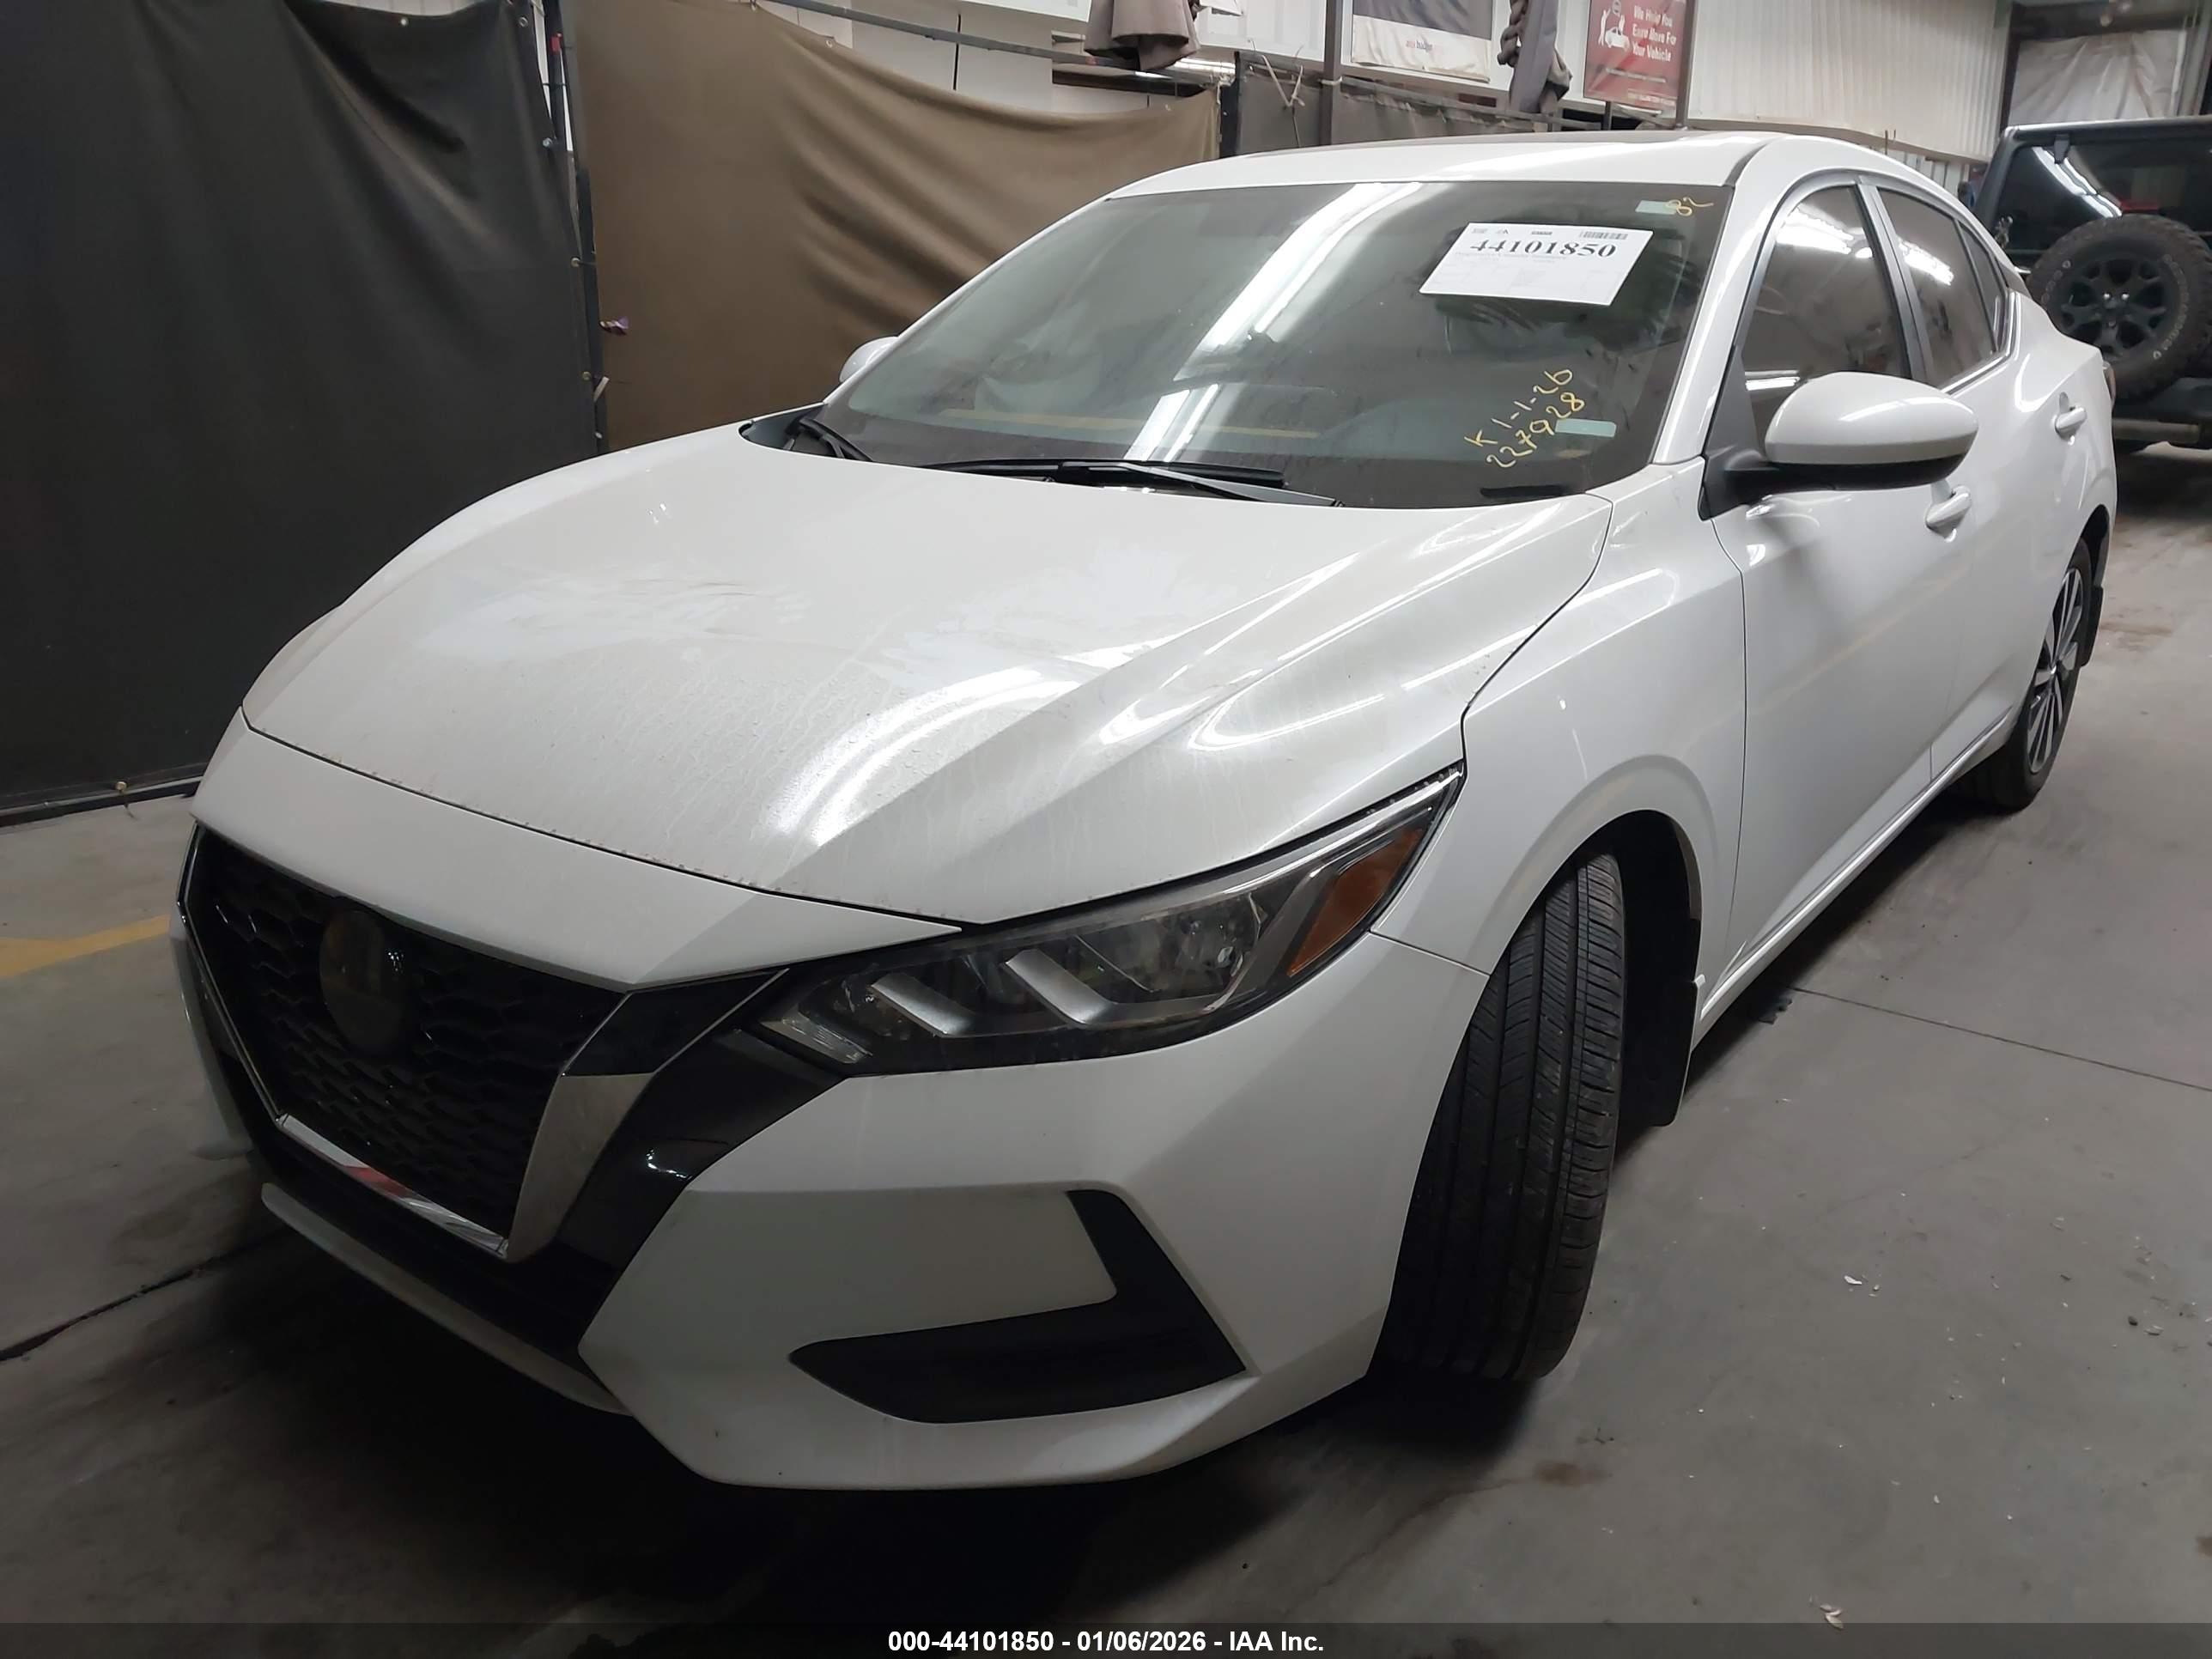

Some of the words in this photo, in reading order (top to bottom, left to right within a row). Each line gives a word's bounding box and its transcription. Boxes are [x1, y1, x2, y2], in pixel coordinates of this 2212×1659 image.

[1646, 45, 1672, 62] Vehicle
[1470, 239, 1617, 258] 44101850
[1464, 429, 1498, 447] K
